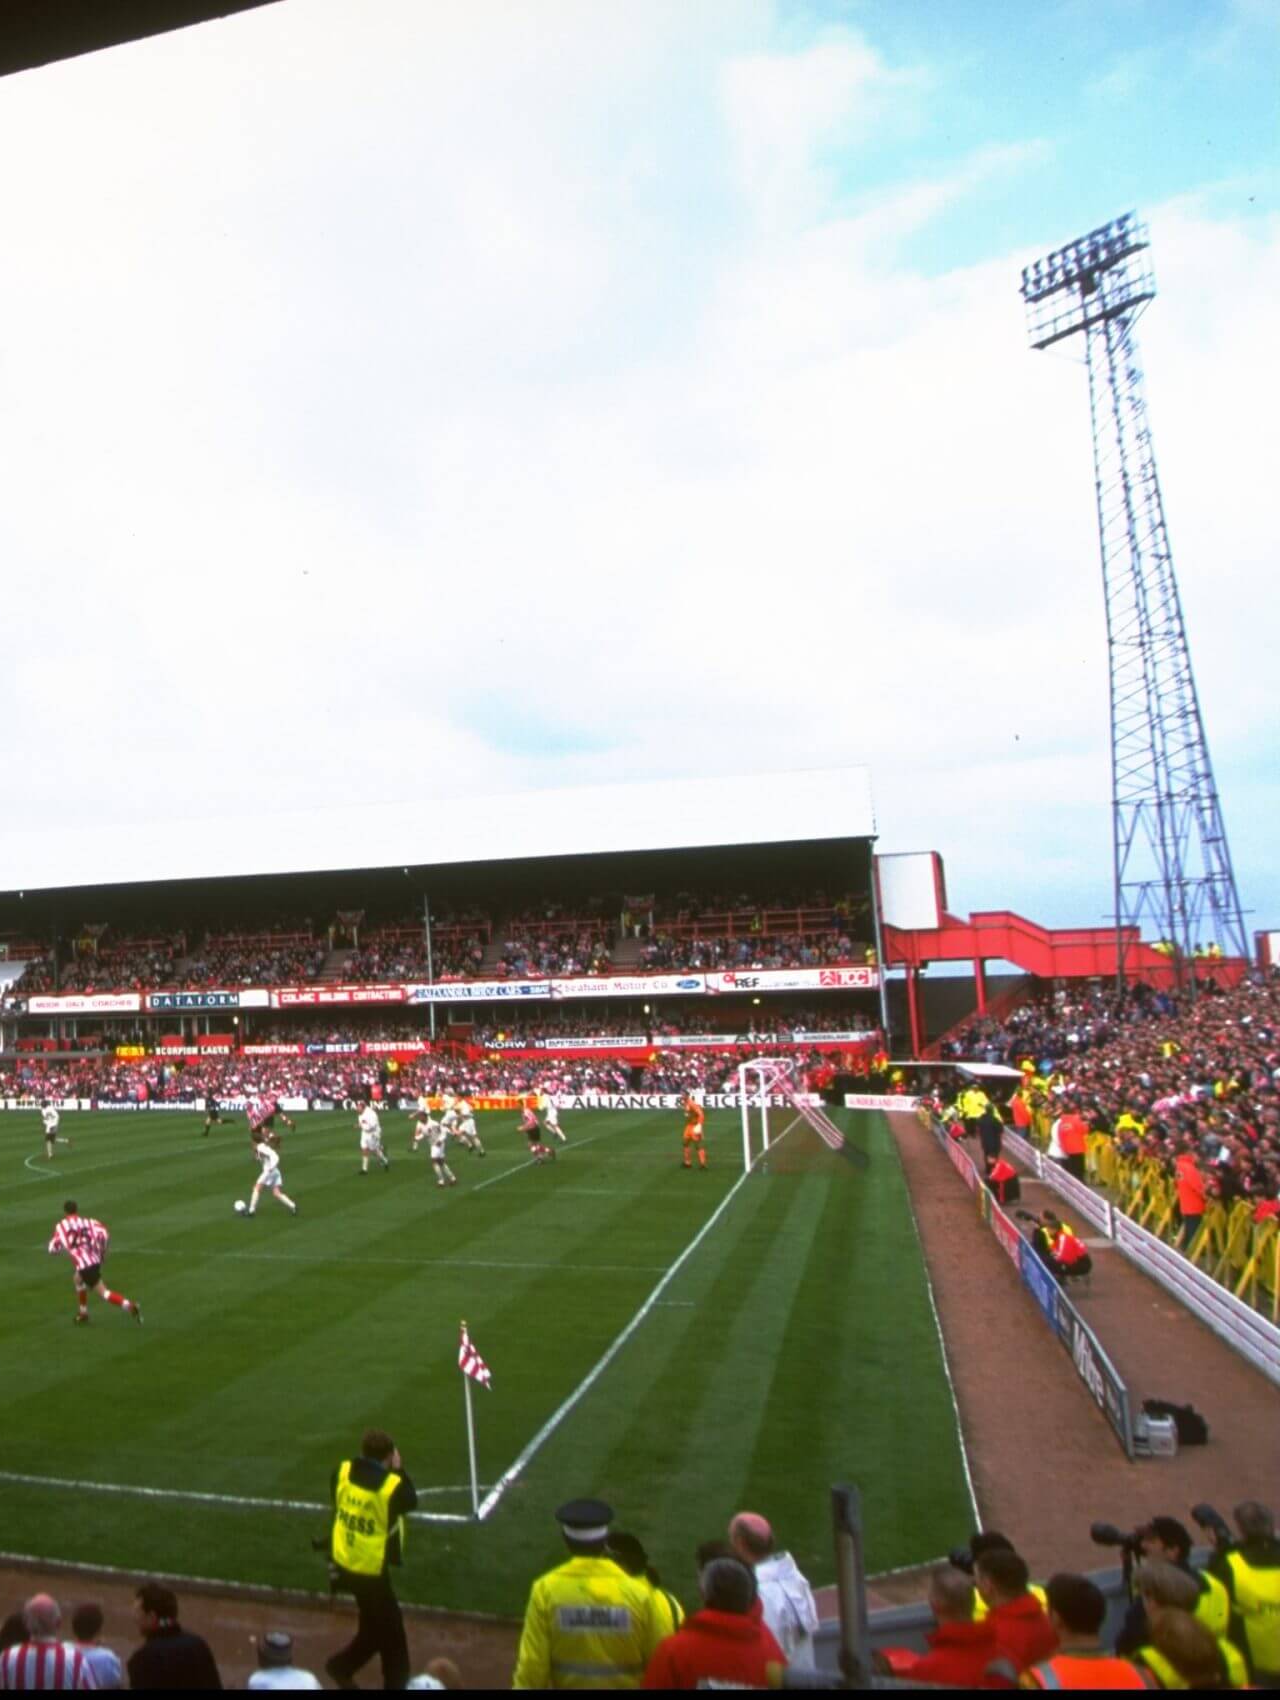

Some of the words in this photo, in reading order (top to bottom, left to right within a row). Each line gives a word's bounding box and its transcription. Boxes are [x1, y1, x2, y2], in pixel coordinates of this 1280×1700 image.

[614, 981, 647, 991] Motor
[734, 977, 760, 988] REF
[152, 995, 239, 1005] DATAFORM
[484, 1040, 545, 1049] NORWB
[97, 1100, 137, 1111] University
[138, 1099, 148, 1110] of
[149, 1099, 195, 1110] Sunderland
[572, 1095, 668, 1109] ALLIANCE
[339, 1508, 377, 1537] PRESS
